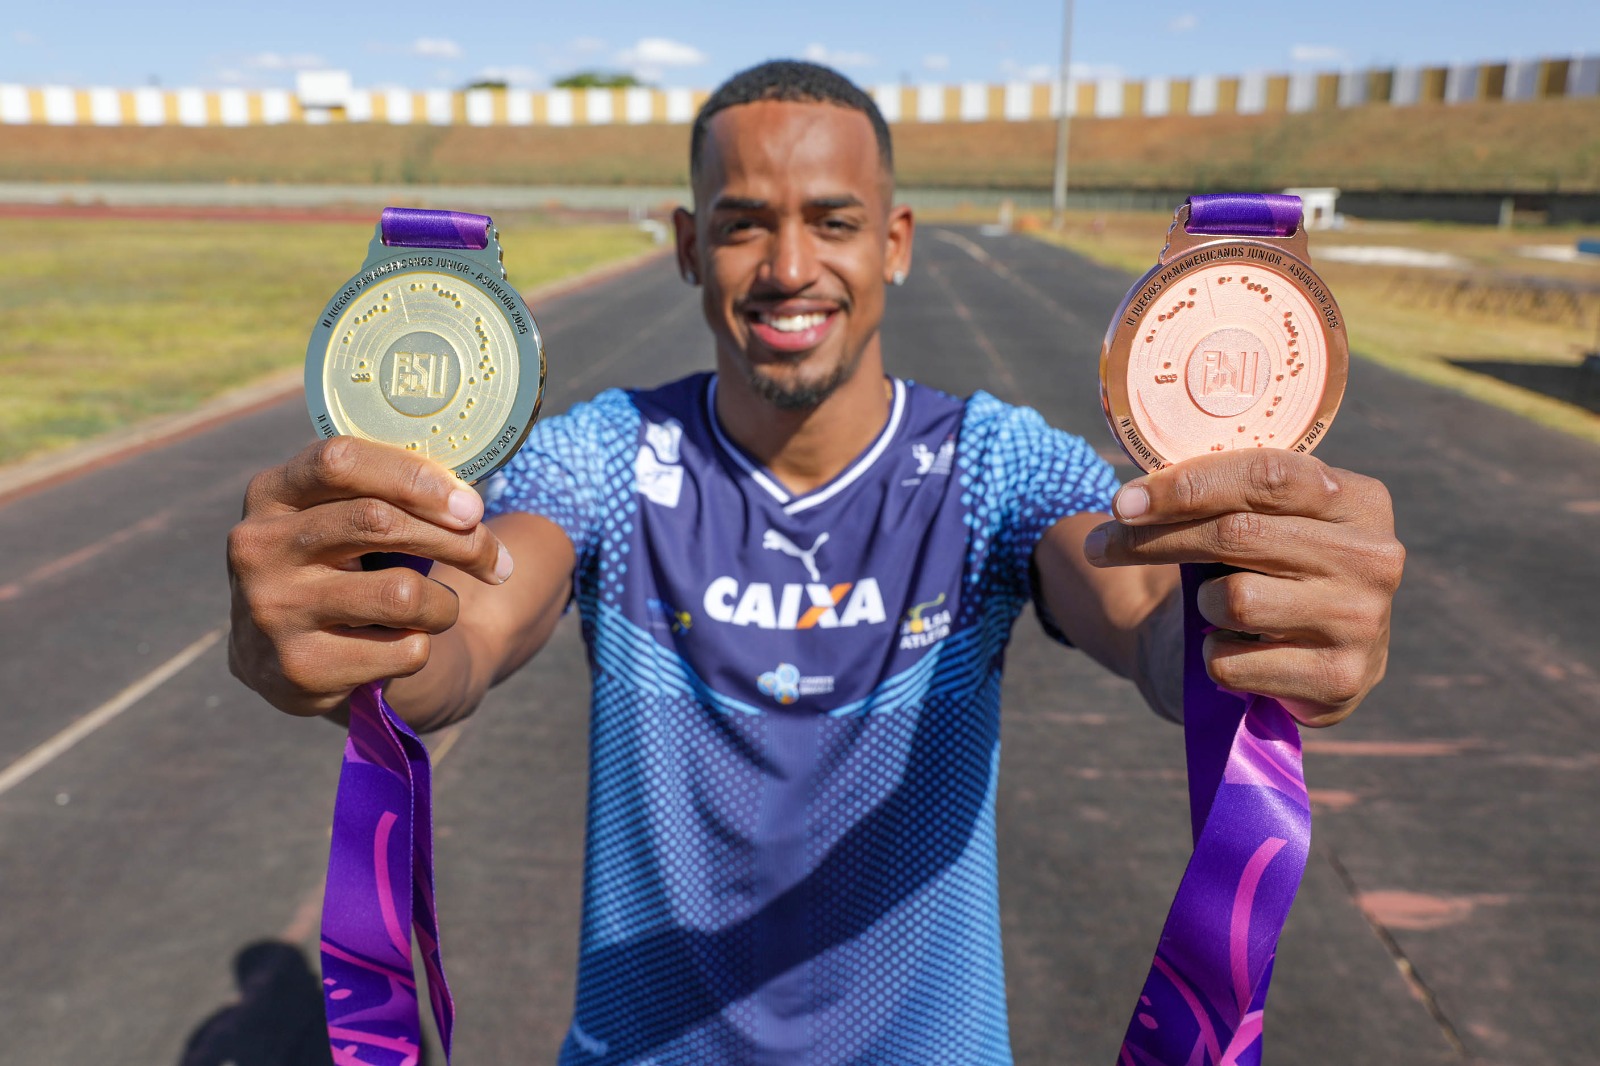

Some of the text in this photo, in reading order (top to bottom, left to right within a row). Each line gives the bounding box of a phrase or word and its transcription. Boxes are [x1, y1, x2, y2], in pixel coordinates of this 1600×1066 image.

[322, 318, 332, 328] II
[328, 287, 356, 320] JUEGOS
[355, 257, 434, 290] PANAMERICANOS
[436, 257, 470, 275] JUNIOR
[511, 310, 528, 335] 2025
[1125, 317, 1136, 326] II
[1132, 281, 1162, 317] JUEGOS
[1160, 247, 1244, 285] PANAMERICANOS
[1247, 247, 1282, 266] JUNIOR
[1322, 304, 1339, 328] 2025
[317, 414, 326, 423] II
[1121, 419, 1131, 427] II
[498, 425, 517, 449] 2025
[1125, 428, 1151, 460] JUNIOR
[1304, 421, 1324, 445] 2025
[703, 575, 886, 629] CAIXA
